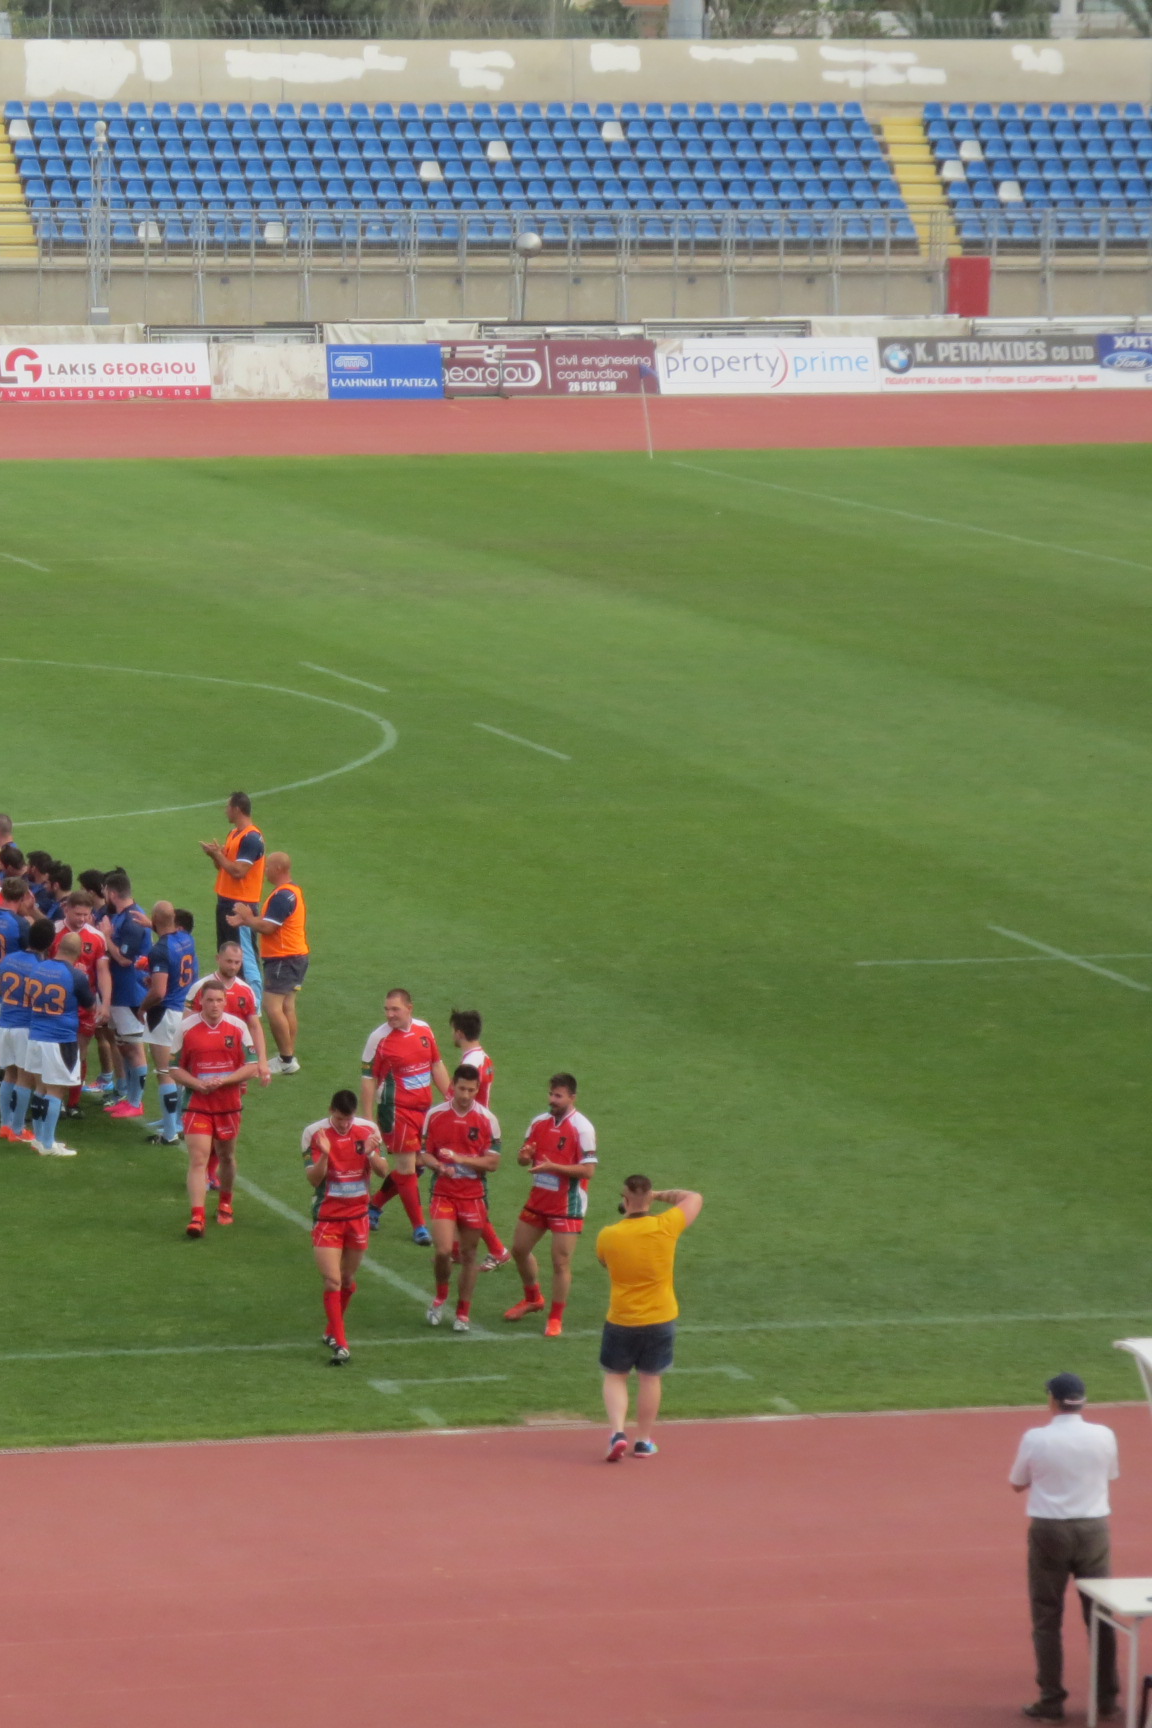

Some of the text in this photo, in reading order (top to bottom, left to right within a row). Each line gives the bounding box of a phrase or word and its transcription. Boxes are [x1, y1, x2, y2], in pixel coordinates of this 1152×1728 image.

[915, 340, 1094, 361] K. PETRAKIDES CO LTD
[555, 355, 652, 367] civil engineering
[793, 352, 869, 378] prime
[1114, 355, 1147, 368] Ford
[48, 362, 196, 376] LAKIS GEORGIOU
[557, 369, 628, 380] construction
[332, 378, 438, 387] ΕΛΛΗΝΙΚΗ ΤΡΑΠΕΖΑ
[568, 381, 581, 392] 26
